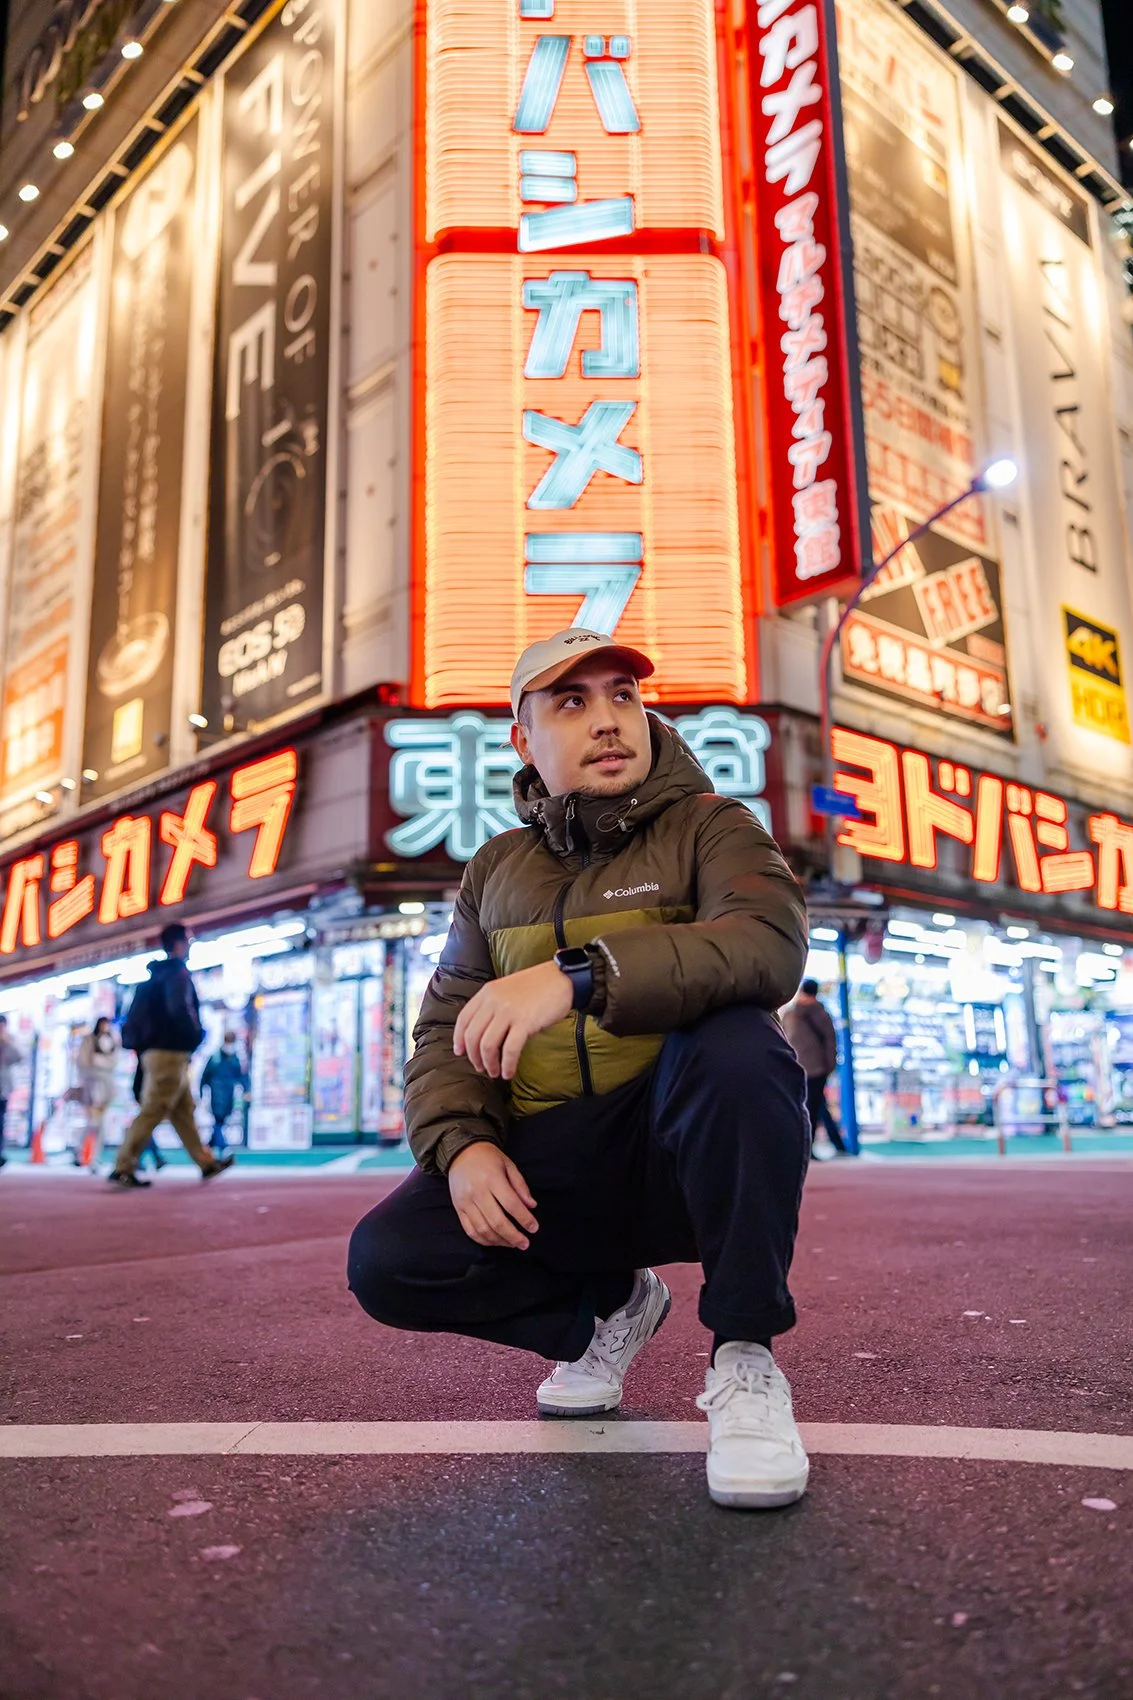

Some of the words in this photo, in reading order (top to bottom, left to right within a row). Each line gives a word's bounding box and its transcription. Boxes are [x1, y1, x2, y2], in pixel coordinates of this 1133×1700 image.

[283, 274, 319, 364] OF
[512, 0, 643, 636] バシカメラ
[0, 745, 297, 954] バシカメラ
[614, 882, 660, 897] Columbia
[830, 726, 1133, 914] ヨドバシカ
